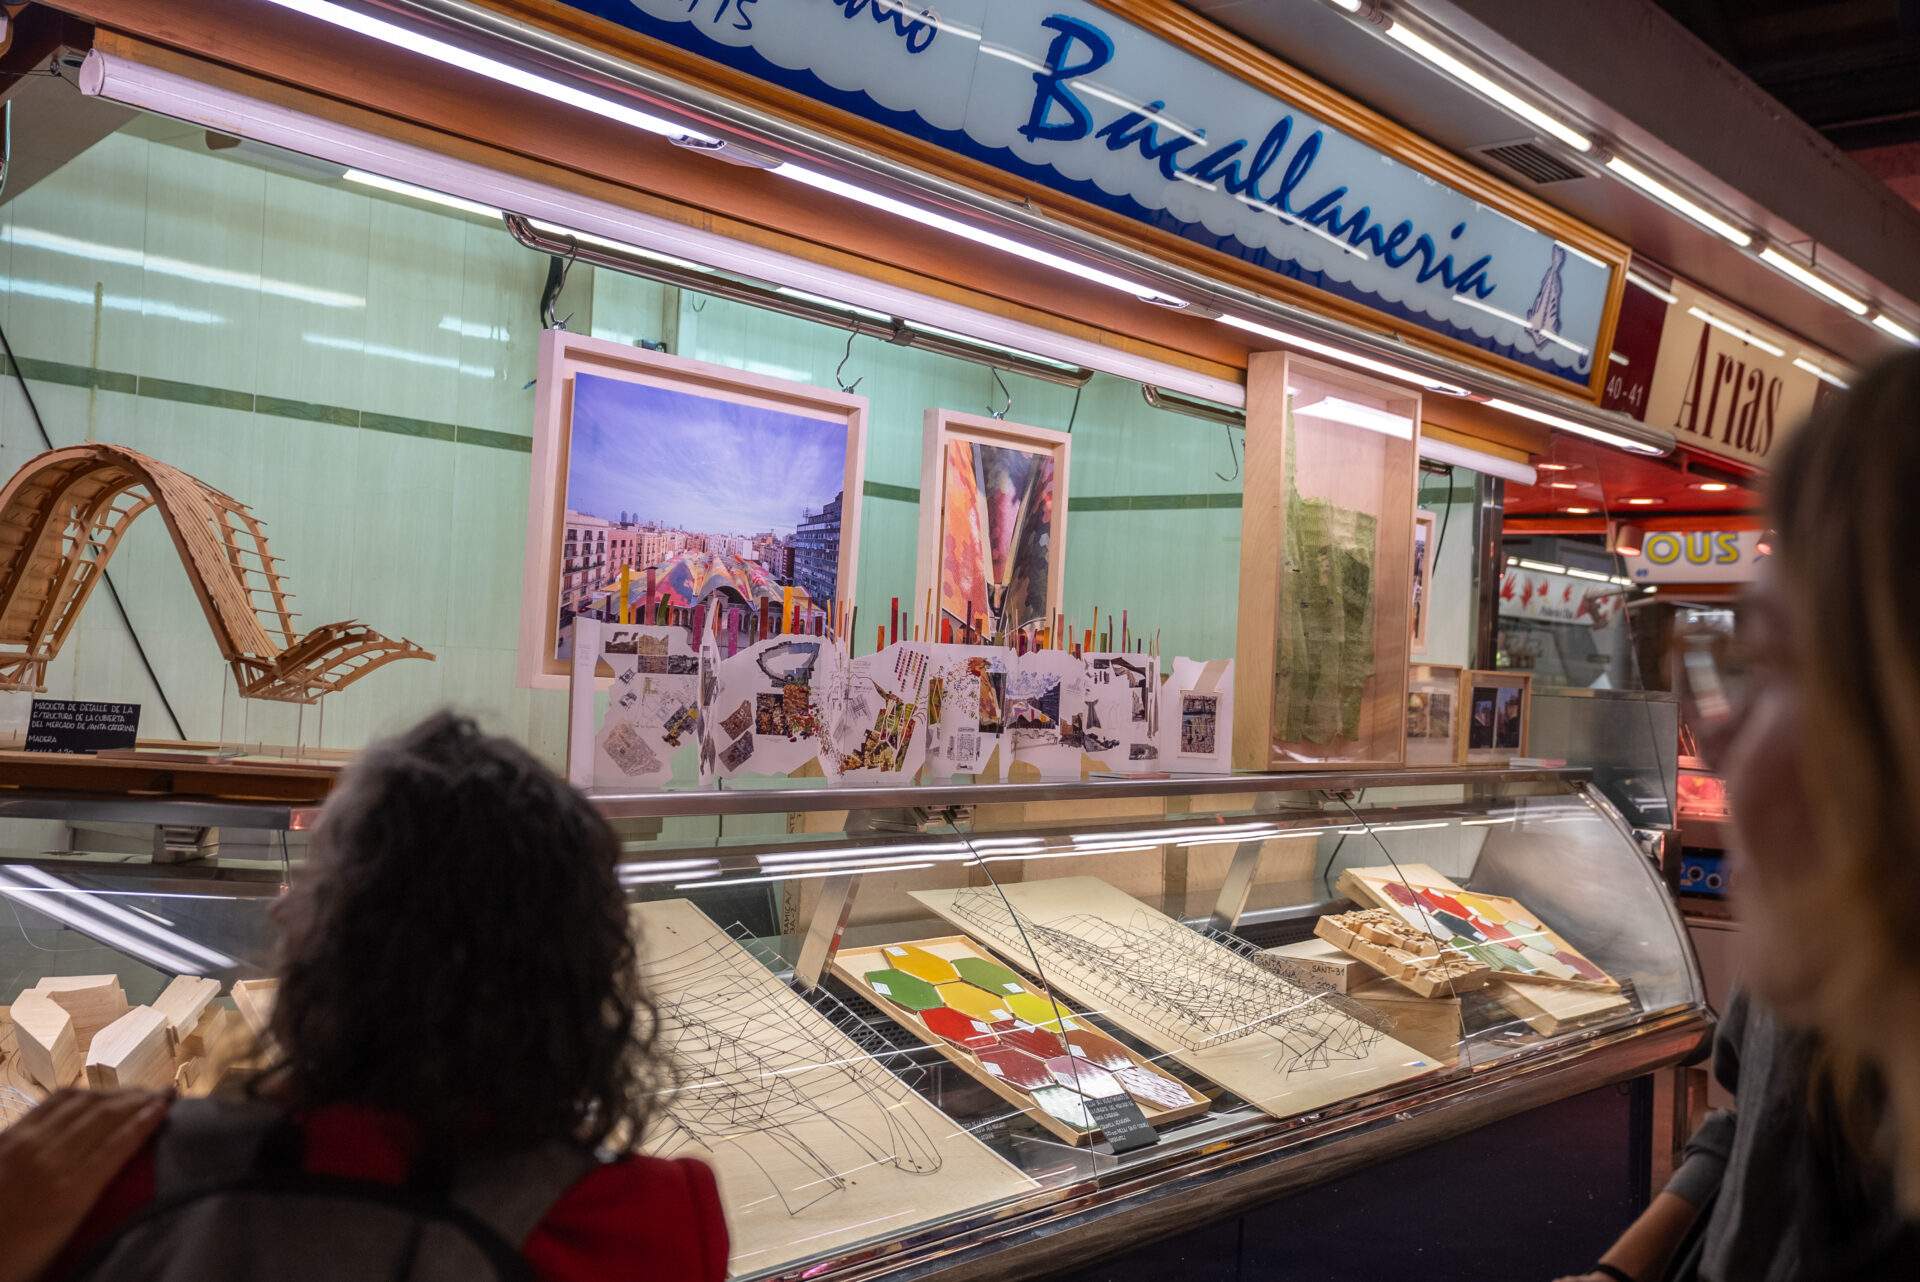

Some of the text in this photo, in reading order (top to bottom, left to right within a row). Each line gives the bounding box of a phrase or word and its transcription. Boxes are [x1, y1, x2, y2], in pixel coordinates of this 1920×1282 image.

[1673, 313, 1784, 458] Arias
[1645, 530, 1741, 566] OUS
[67, 703, 77, 712] DE
[79, 703, 108, 713] DETALLE
[111, 705, 120, 714] DE
[122, 705, 134, 714] LA
[75, 713, 84, 722] DE
[85, 714, 94, 722] LA
[31, 720, 44, 728] DEL
[45, 721, 75, 730] MERCADO
[76, 722, 85, 730] DE
[28, 735, 57, 743] MADERA
